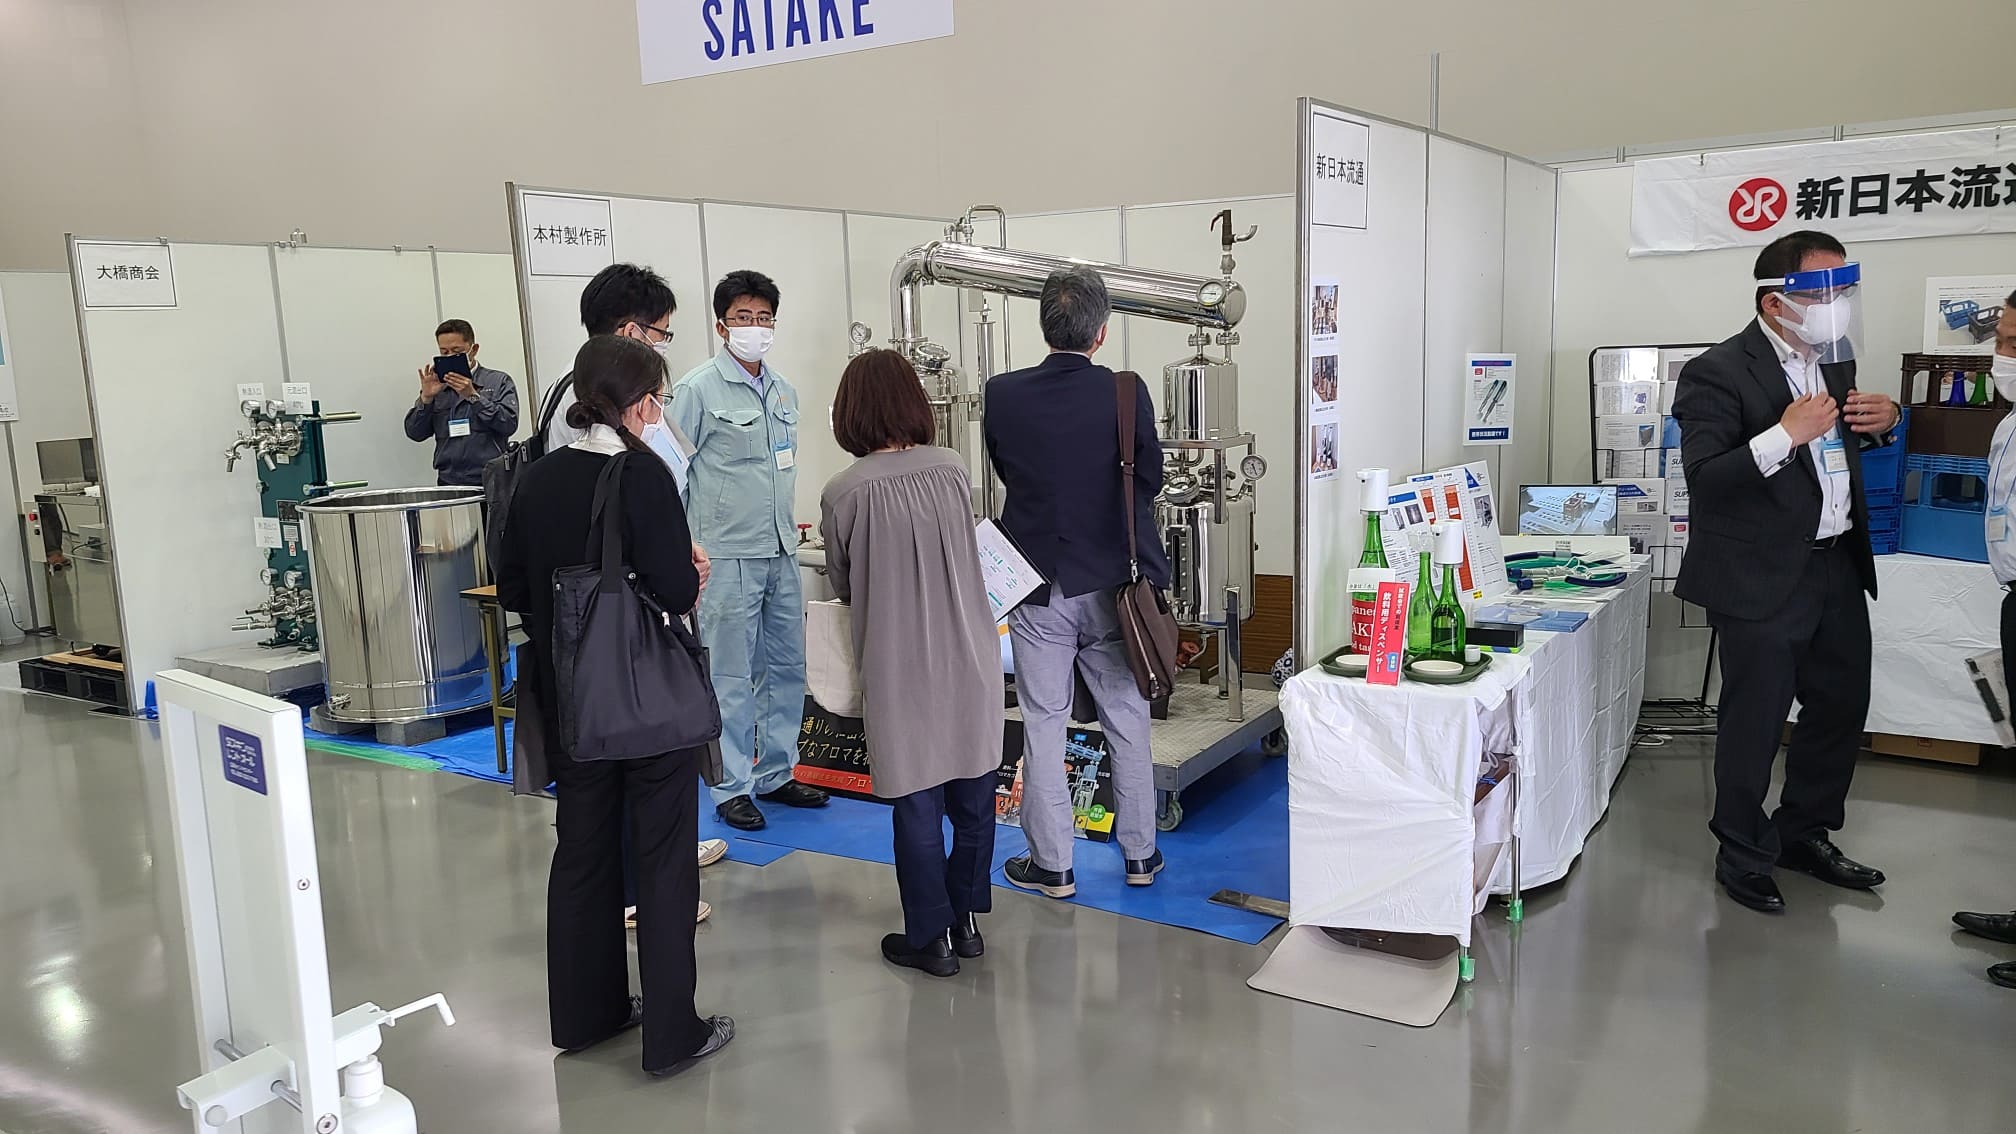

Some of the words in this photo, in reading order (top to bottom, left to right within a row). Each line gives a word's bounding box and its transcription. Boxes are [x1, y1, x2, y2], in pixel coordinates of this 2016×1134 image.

[1316, 153, 1364, 186] 新日本流通
[533, 224, 607, 247] 本村製作所
[96, 264, 160, 281] 大橋商会
[1671, 457, 1683, 466] SU
[1375, 591, 1392, 673] 飲料用ディスペンサー
[847, 776, 871, 788] アロ
